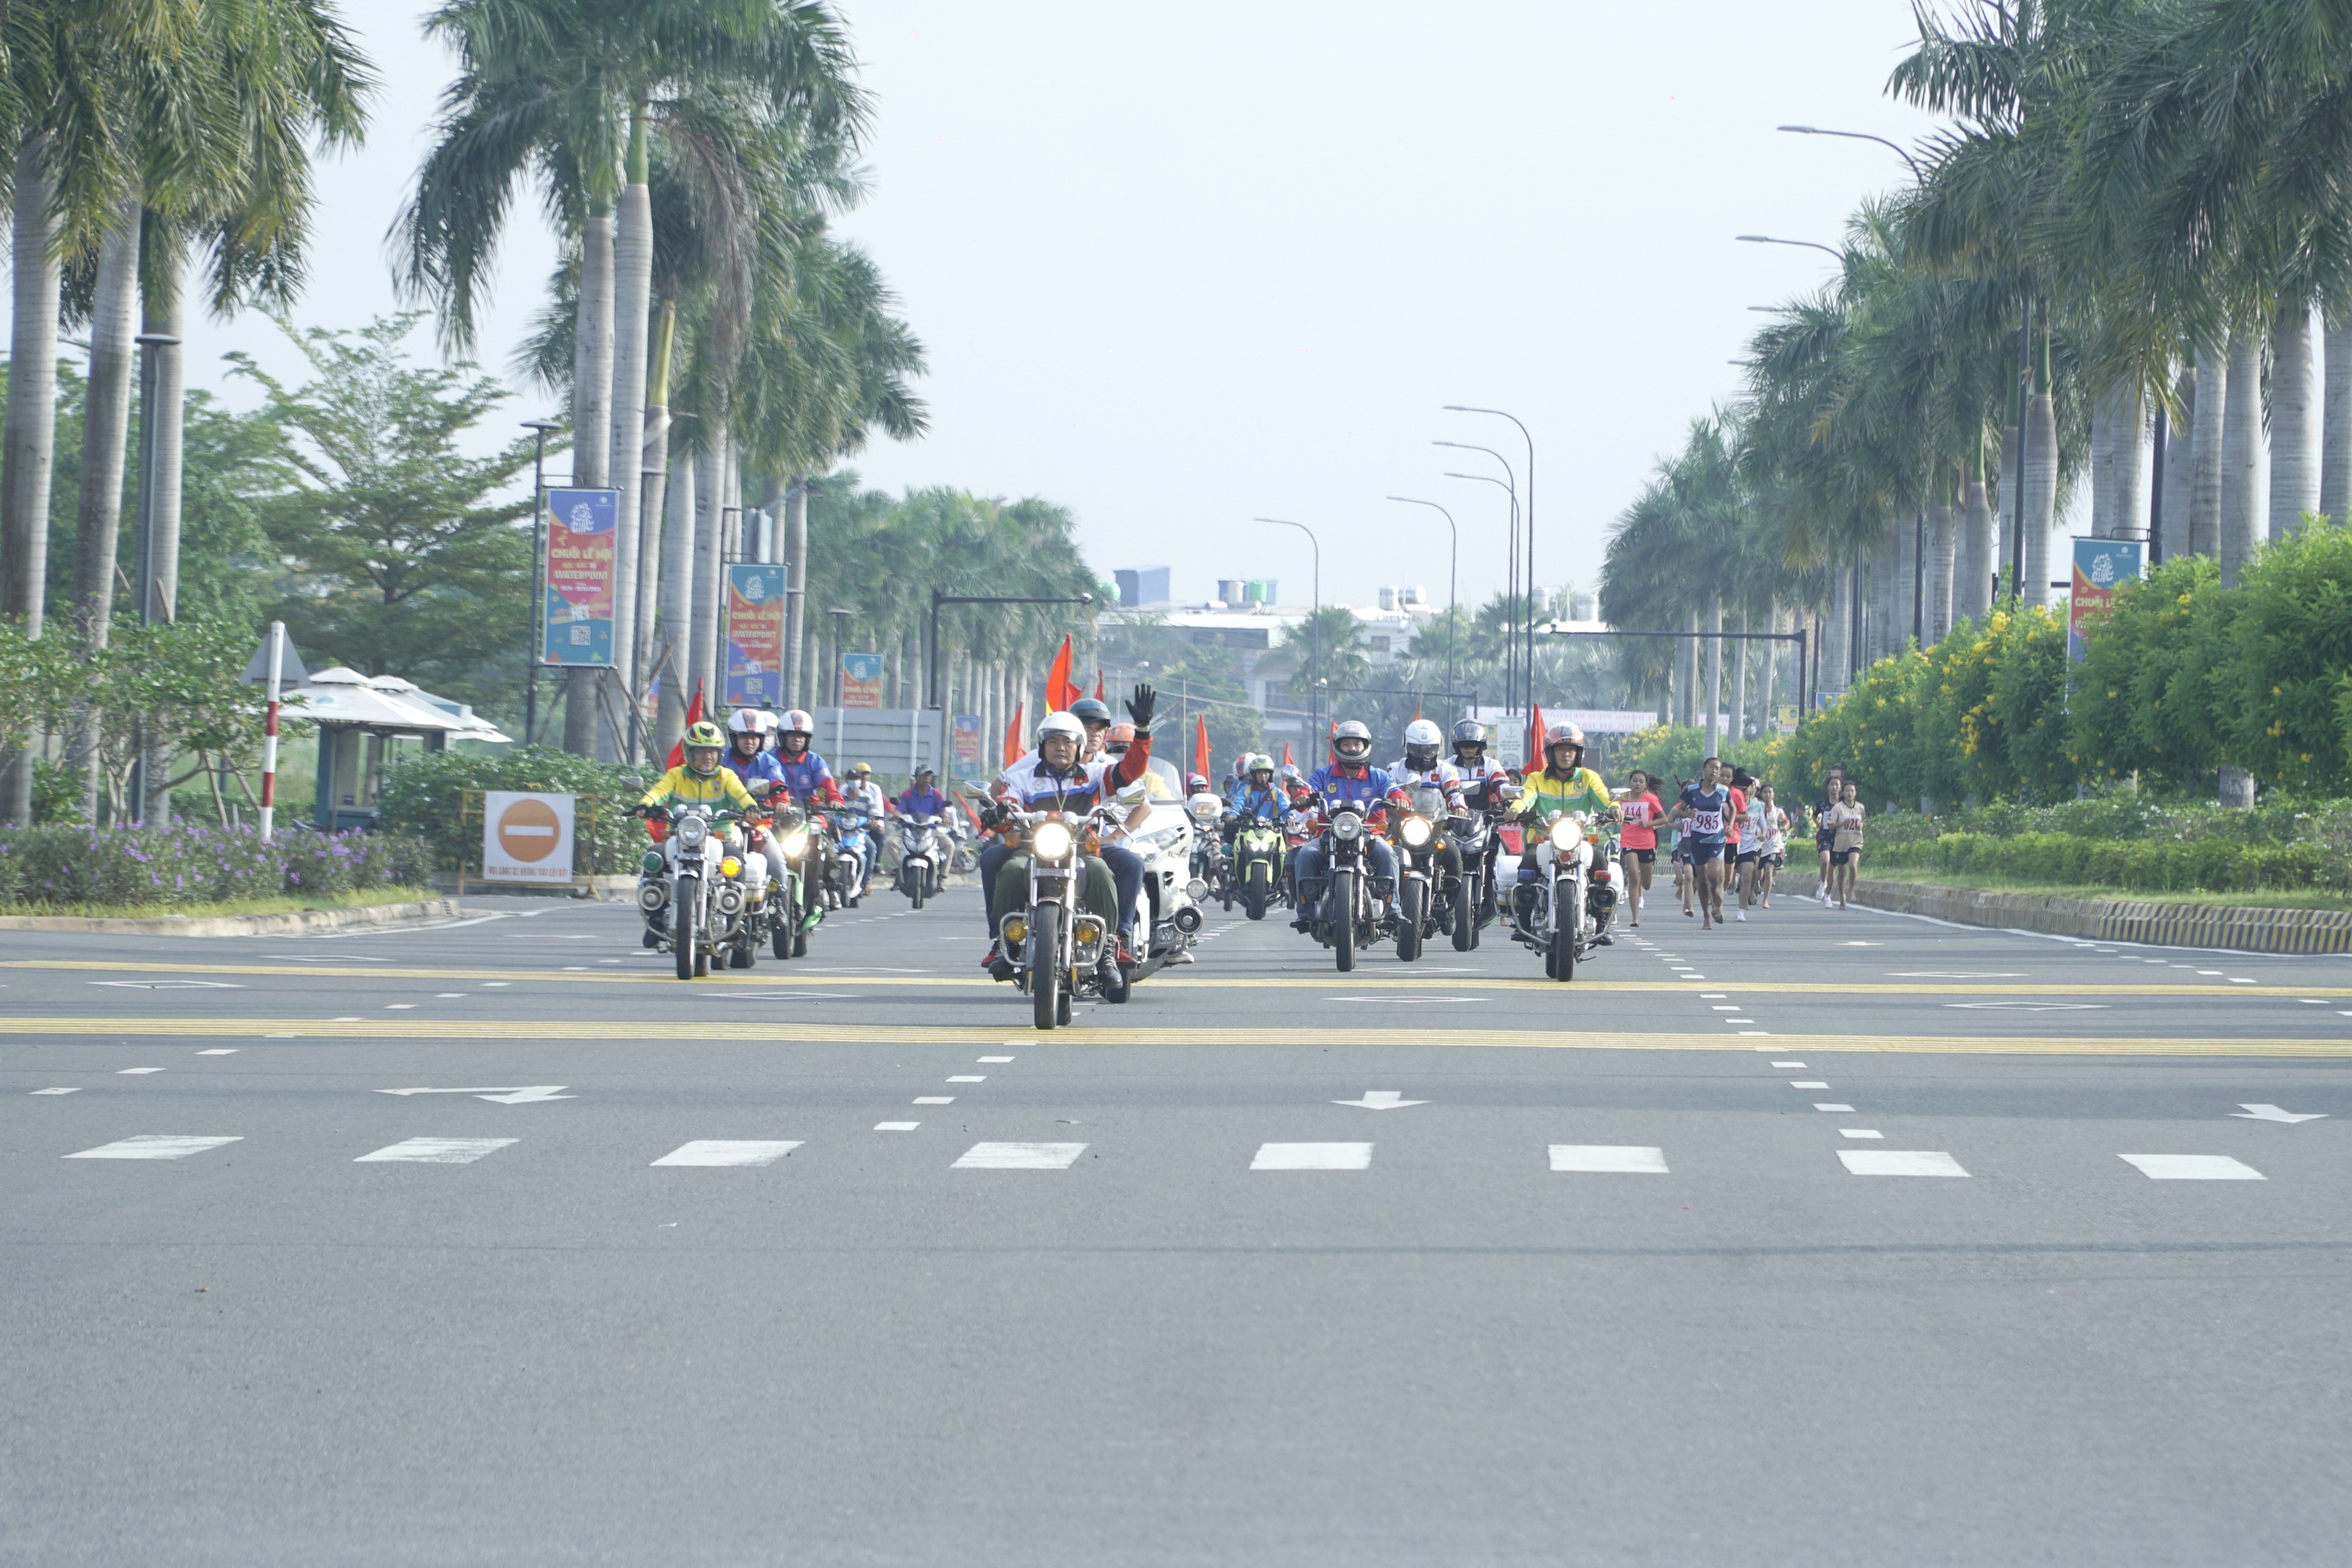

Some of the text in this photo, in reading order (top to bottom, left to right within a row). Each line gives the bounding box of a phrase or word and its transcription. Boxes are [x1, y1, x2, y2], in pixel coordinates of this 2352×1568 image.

[554, 570, 609, 581] WATERPOINT
[733, 630, 777, 638] WATERPOINT
[1696, 814, 1719, 830] 985
